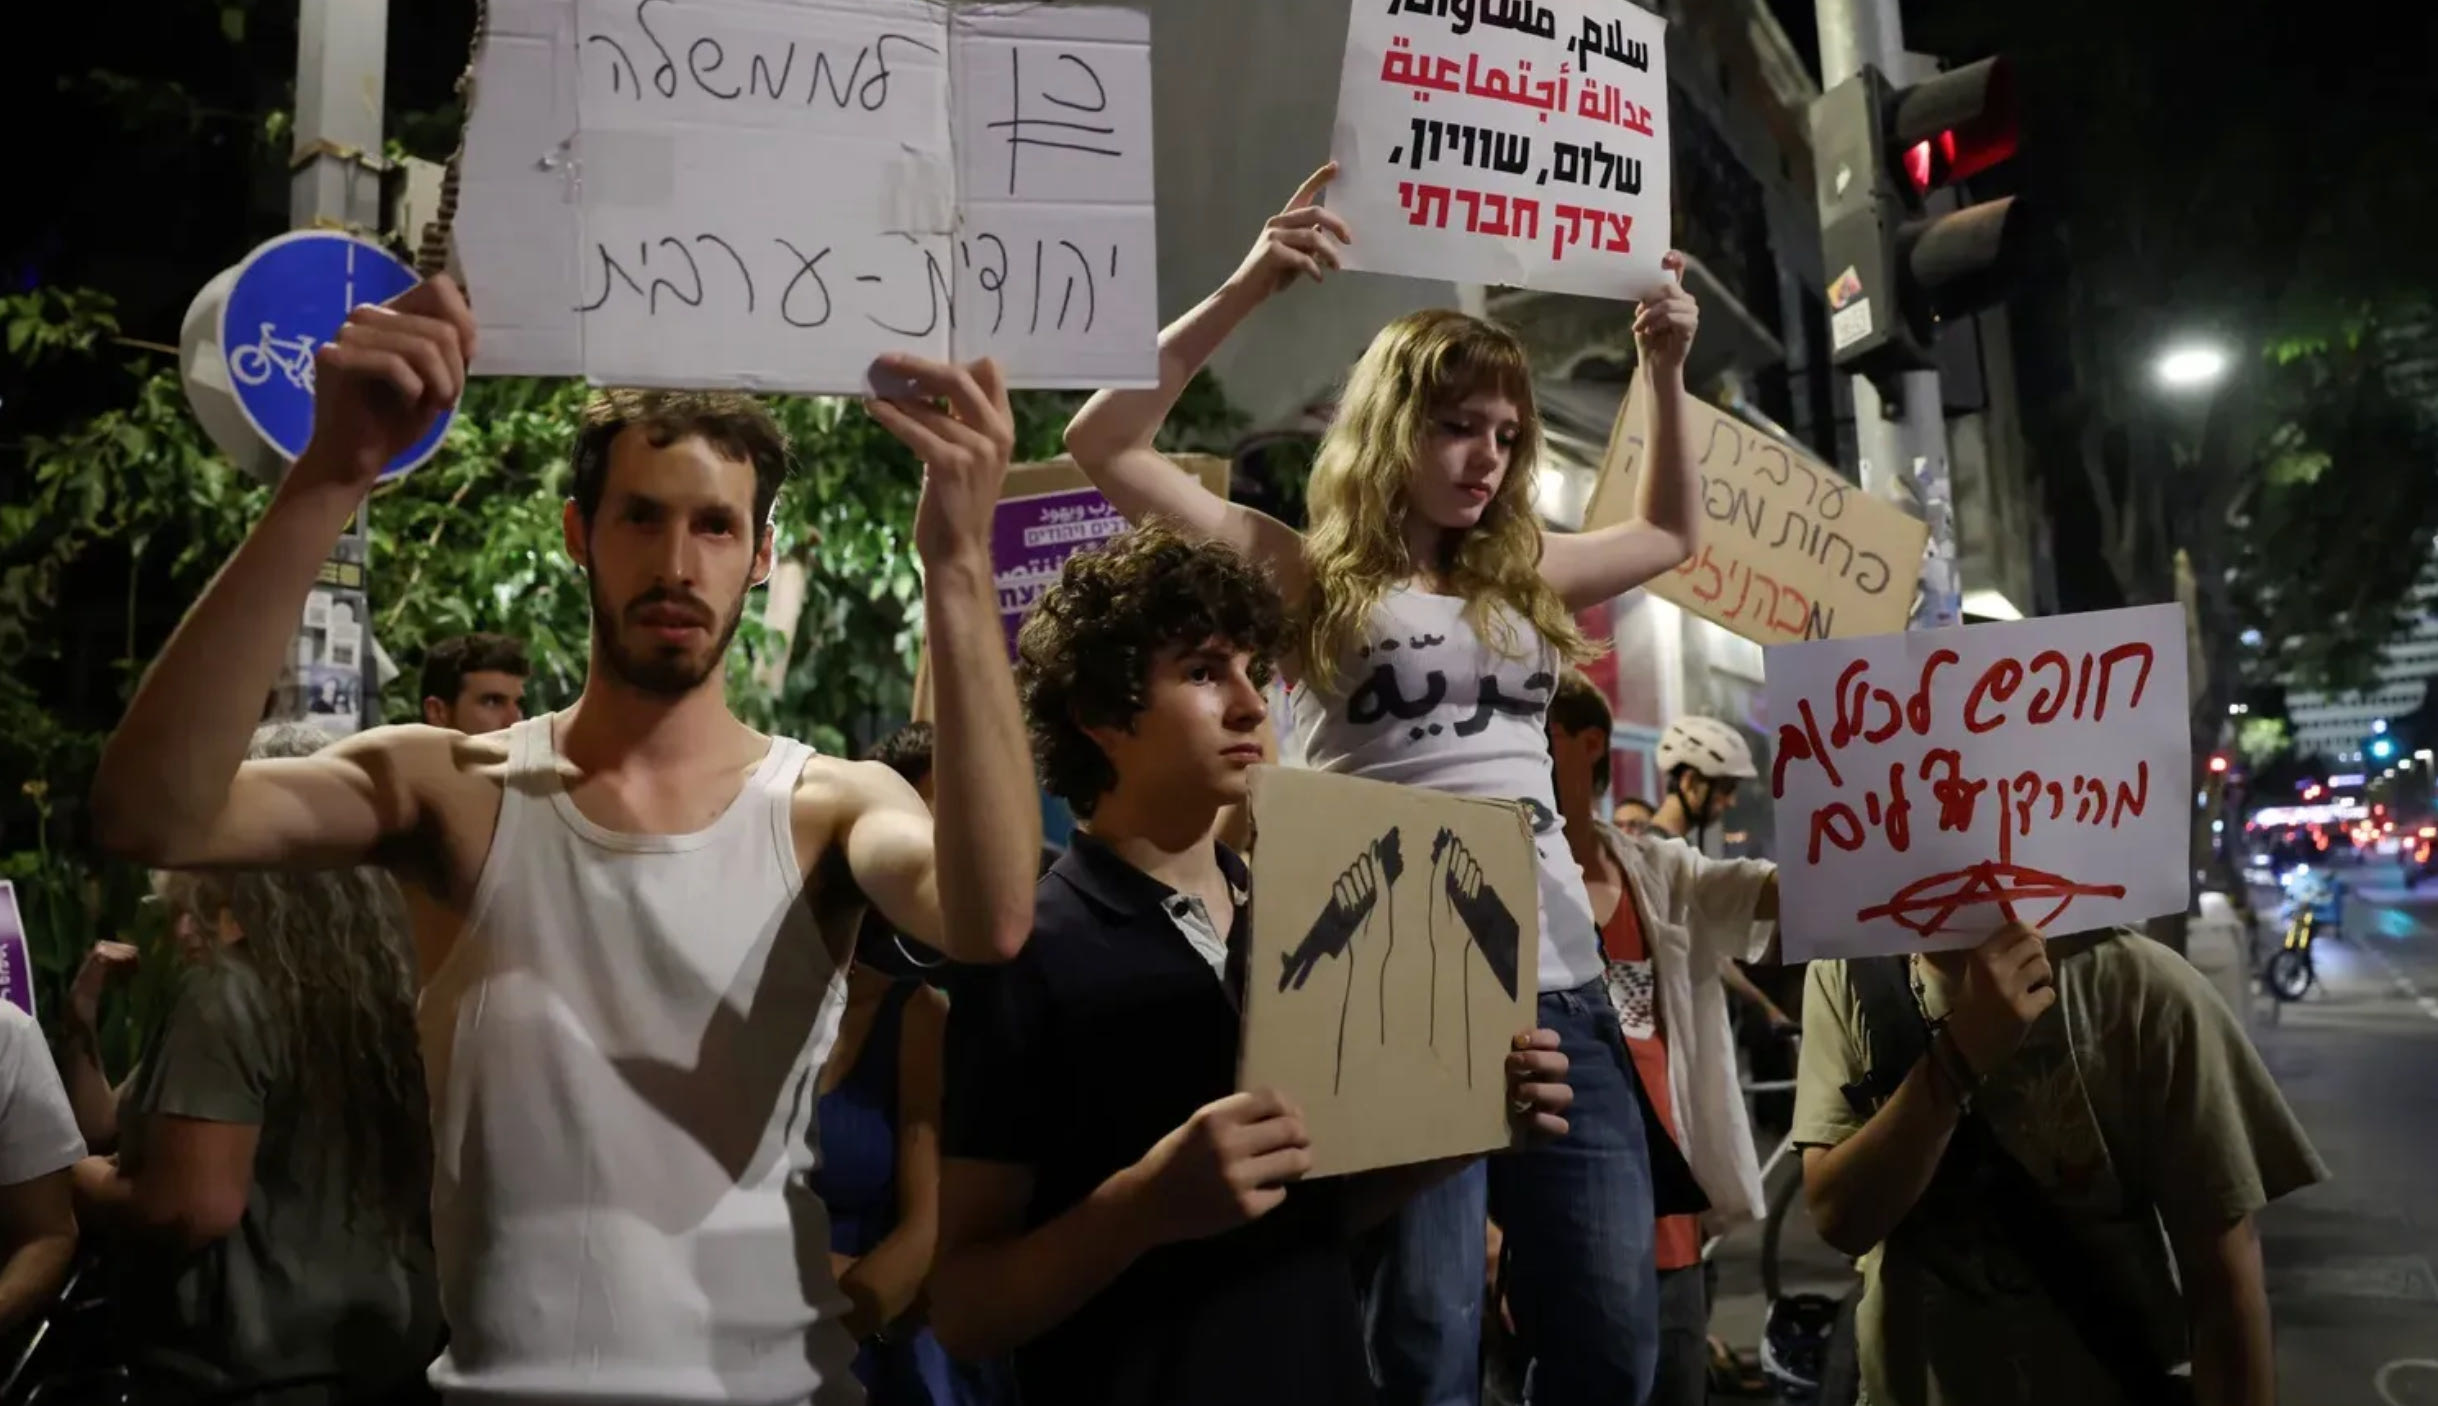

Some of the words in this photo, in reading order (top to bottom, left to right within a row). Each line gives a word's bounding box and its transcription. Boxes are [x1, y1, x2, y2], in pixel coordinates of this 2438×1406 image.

[588, 0, 940, 112] לממשלה
[1380, 36, 1569, 124] أجتماعية
[1004, 45, 1110, 196] כן
[1388, 118, 1530, 176] שוויון,
[1577, 78, 1654, 137] عدالة
[1398, 181, 1540, 240] חברתי
[1536, 141, 1641, 196] שלום,
[1552, 203, 1633, 261] צדק
[1698, 418, 1850, 519] ערבית
[1769, 510, 1891, 595] פחות
[1771, 648, 1959, 800] לכולם
[1963, 643, 2155, 734] חופש
[1808, 763, 1912, 866] לים
[1997, 761, 2149, 867] מהירדן
